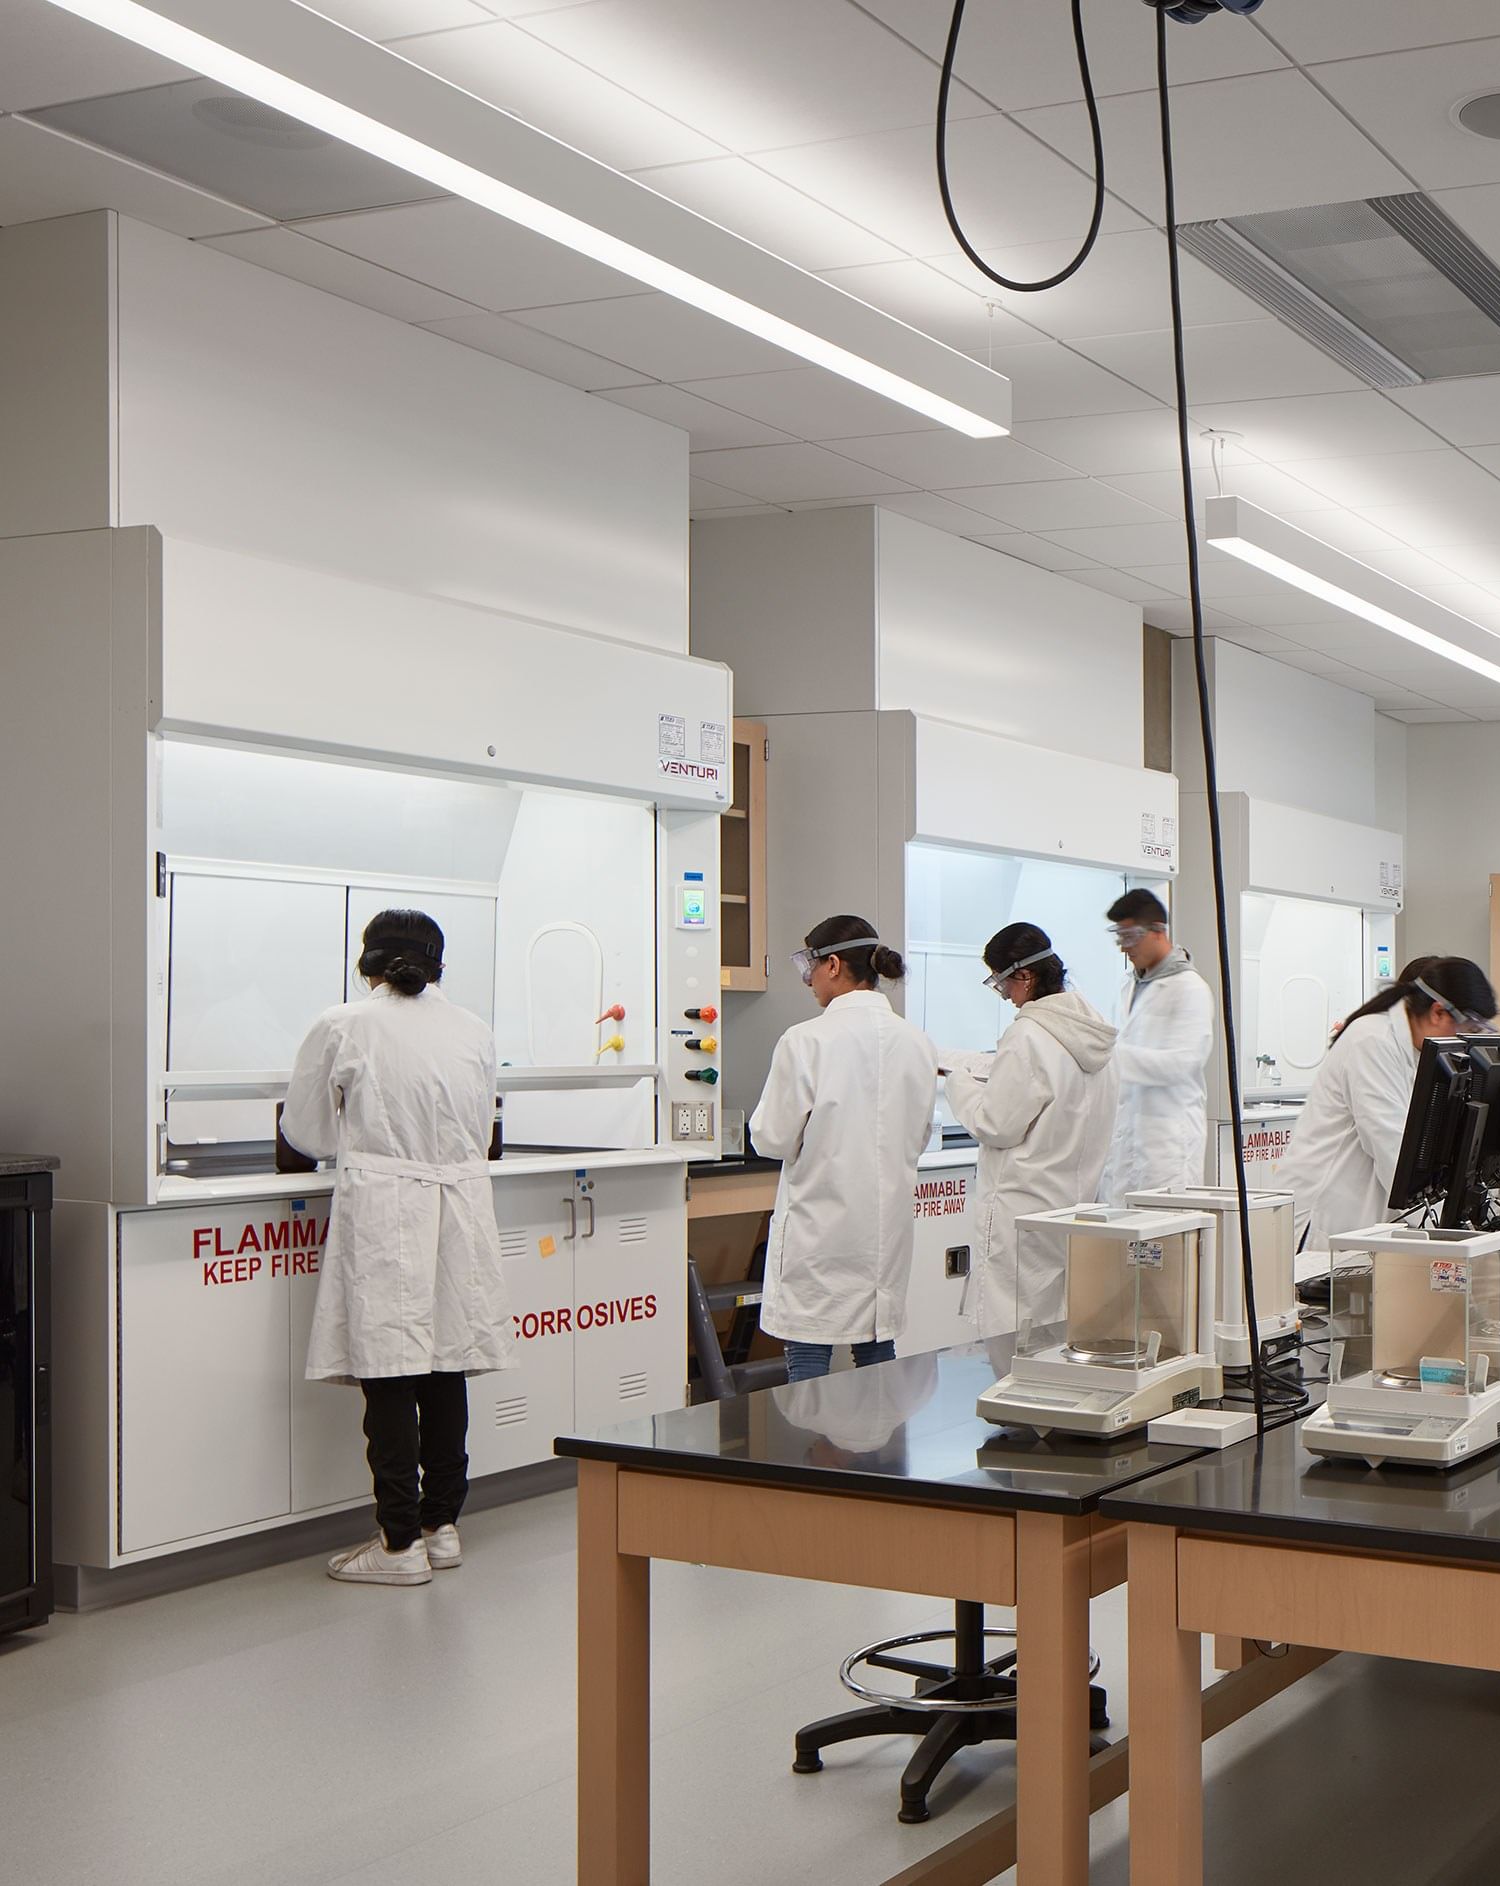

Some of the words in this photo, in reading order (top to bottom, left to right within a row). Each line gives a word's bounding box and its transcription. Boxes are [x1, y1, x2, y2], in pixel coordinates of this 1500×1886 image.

[660, 759, 718, 780] VENTURI
[1256, 1149, 1269, 1161] FIRE
[923, 1201, 942, 1218] FIRE
[943, 1197, 966, 1215] AWAY
[204, 1257, 262, 1286] KEEP
[271, 1250, 319, 1278] FIRE
